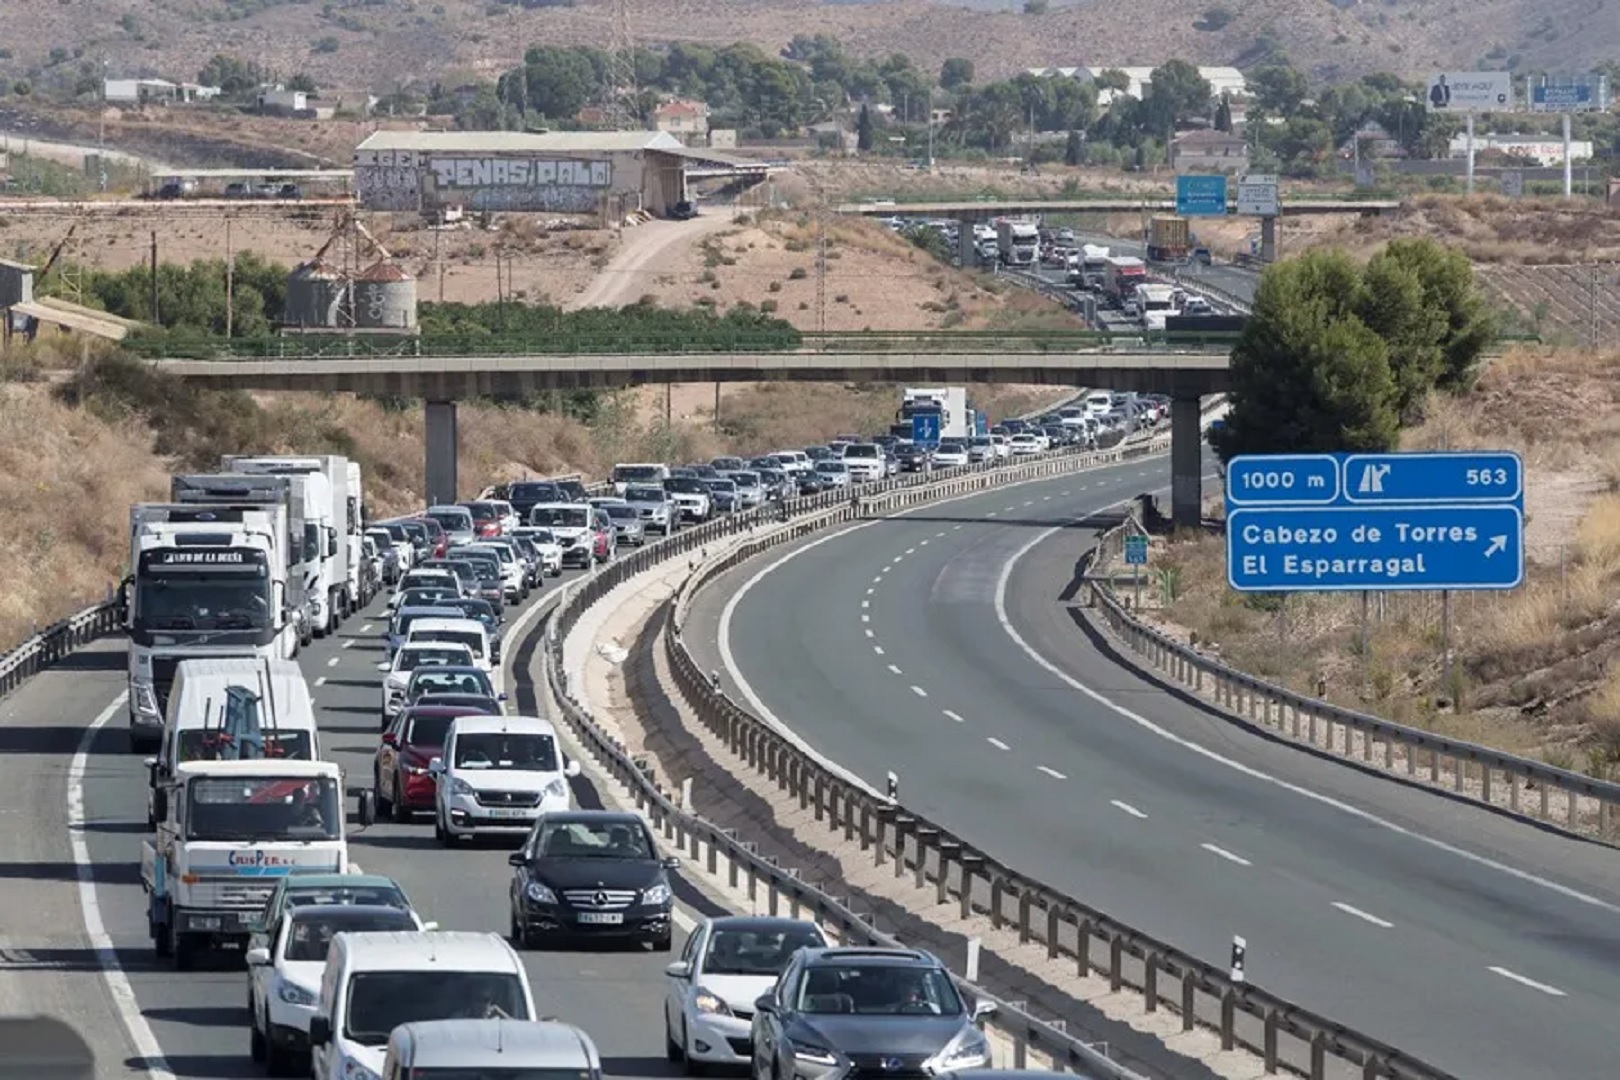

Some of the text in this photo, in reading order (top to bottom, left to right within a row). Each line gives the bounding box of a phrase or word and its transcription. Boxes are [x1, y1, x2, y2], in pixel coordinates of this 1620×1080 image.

[1242, 472, 1325, 489] 1000 m
[1466, 469, 1508, 485] 563
[1242, 523, 1478, 544] Cabezo de Torres
[1243, 553, 1426, 578] El Esparragal
